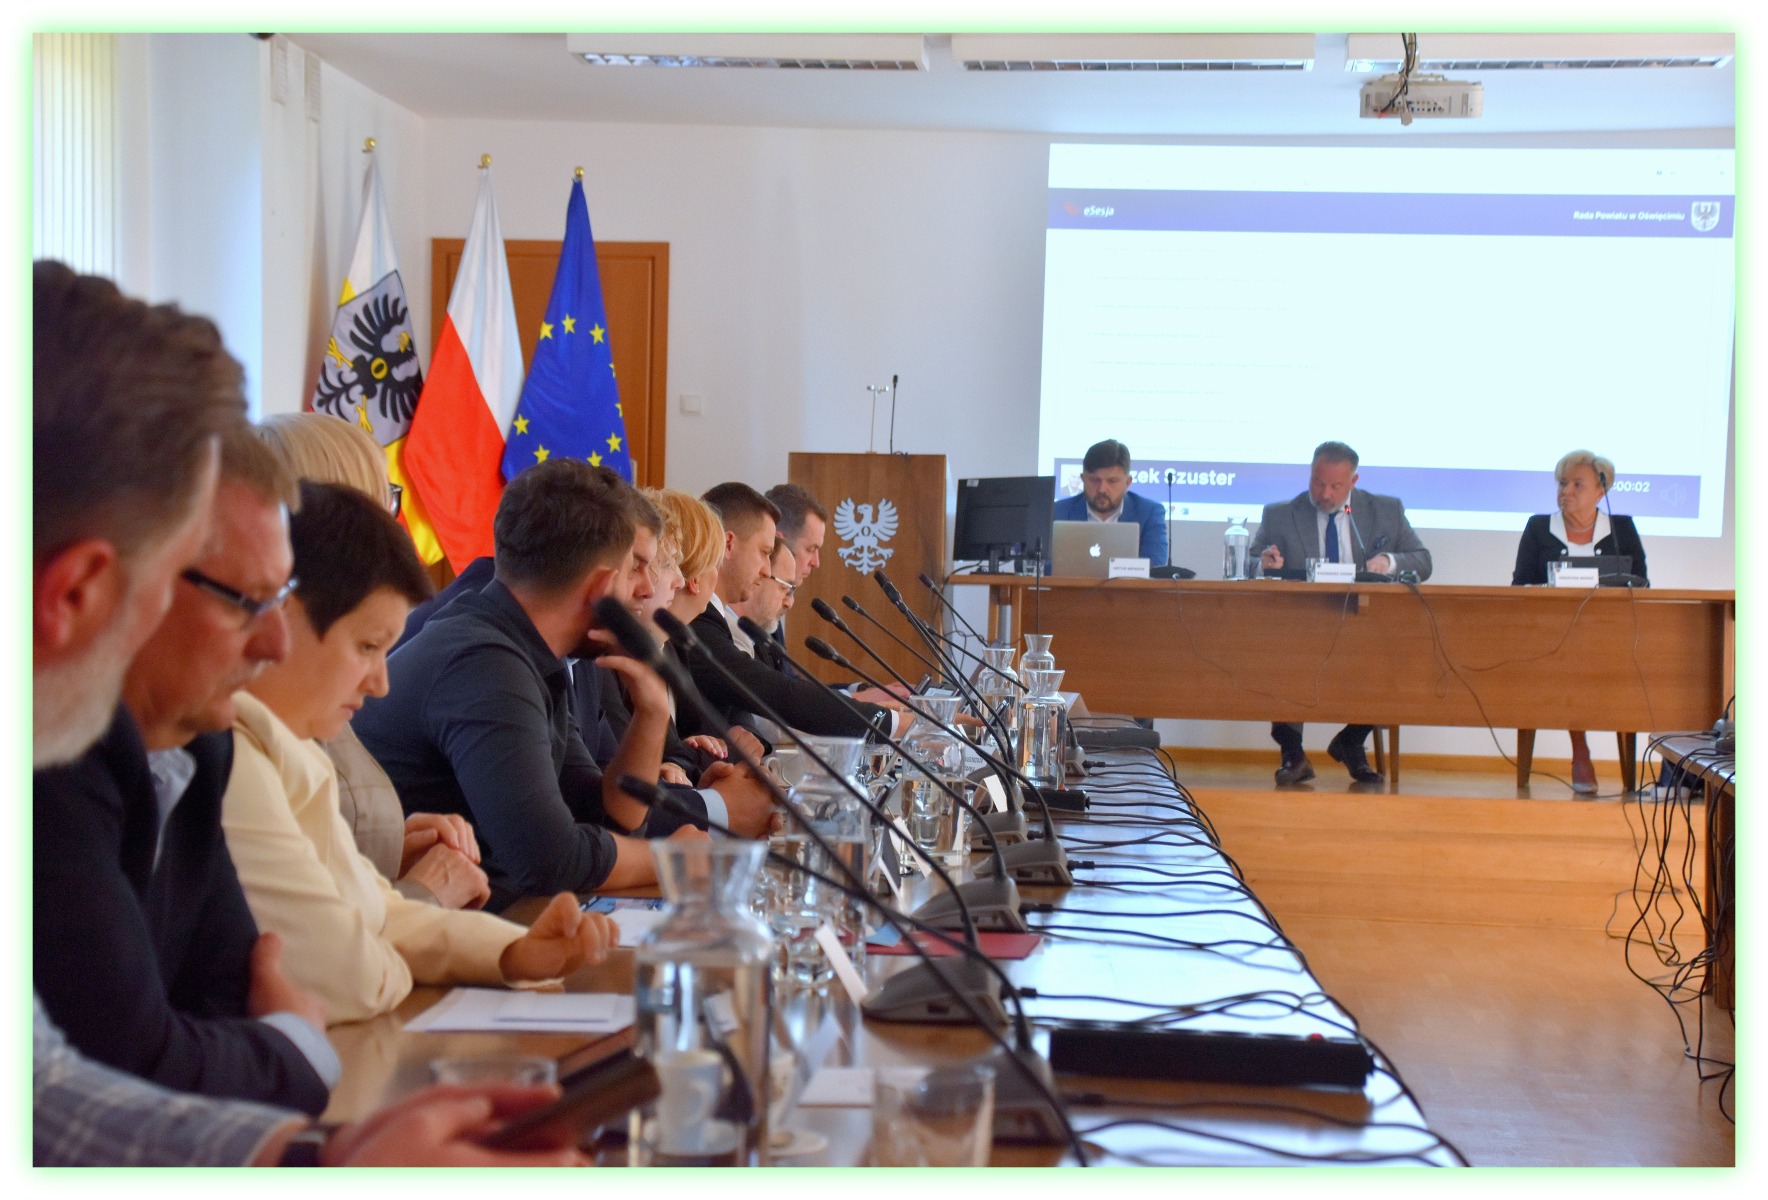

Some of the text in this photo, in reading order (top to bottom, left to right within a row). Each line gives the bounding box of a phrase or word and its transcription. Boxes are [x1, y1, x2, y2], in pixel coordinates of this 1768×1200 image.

[1084, 205, 1115, 217] eSesja
[1573, 211, 1685, 221] Rada Powiatu w Oświęcimiu
[1130, 467, 1236, 485] zek Szuster
